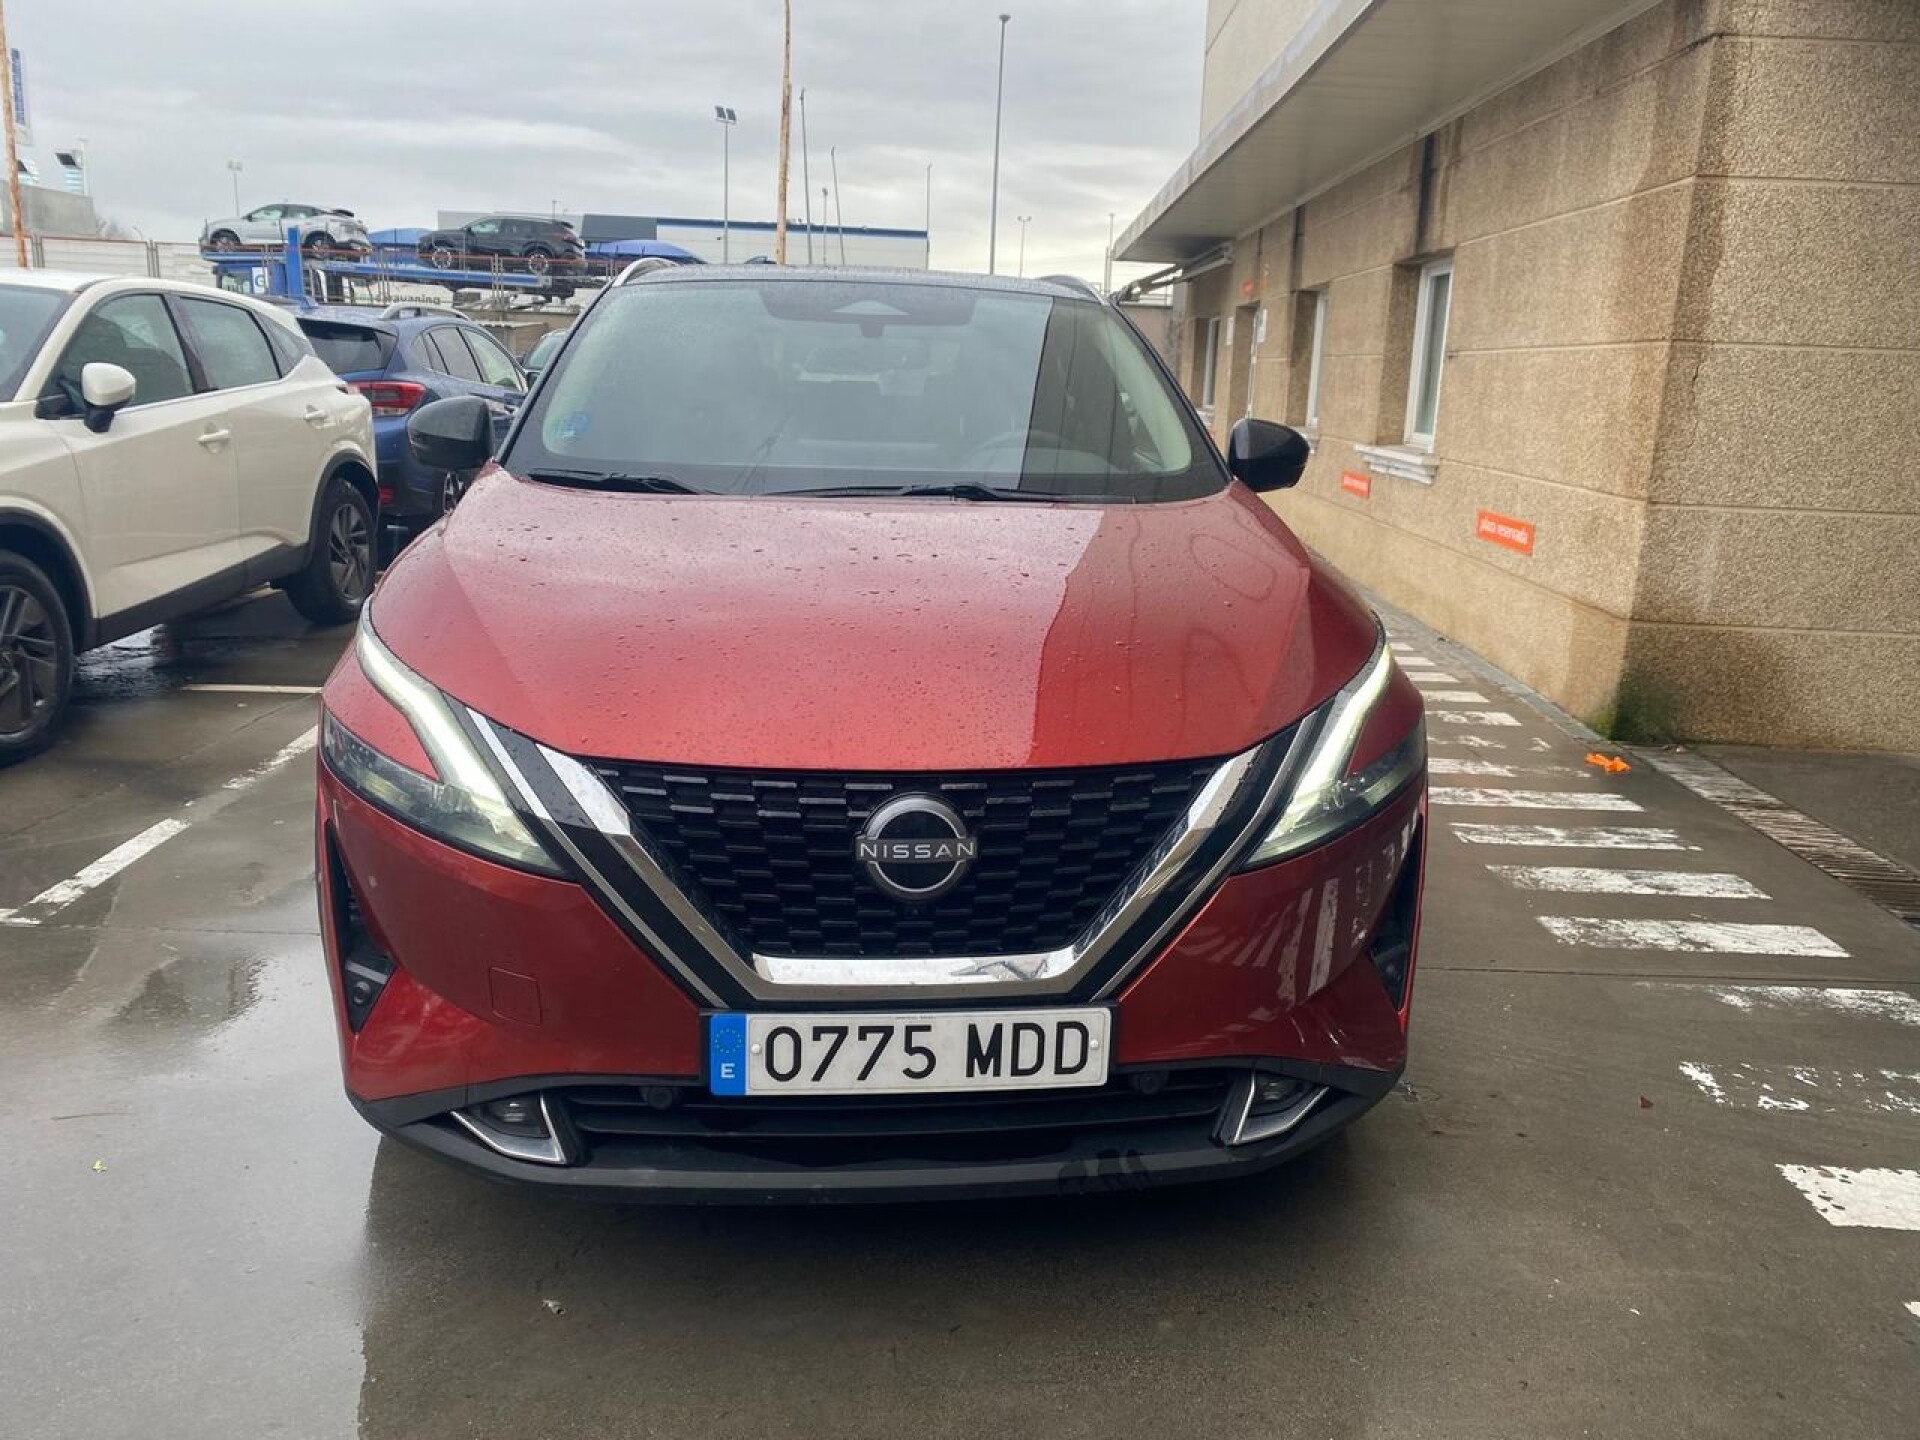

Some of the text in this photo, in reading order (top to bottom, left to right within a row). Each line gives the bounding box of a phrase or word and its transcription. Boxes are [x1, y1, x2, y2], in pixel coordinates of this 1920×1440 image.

[860, 842, 974, 858] NISSAN
[764, 1020, 1090, 1082] 0775 MDD
[720, 1063, 735, 1078] E
